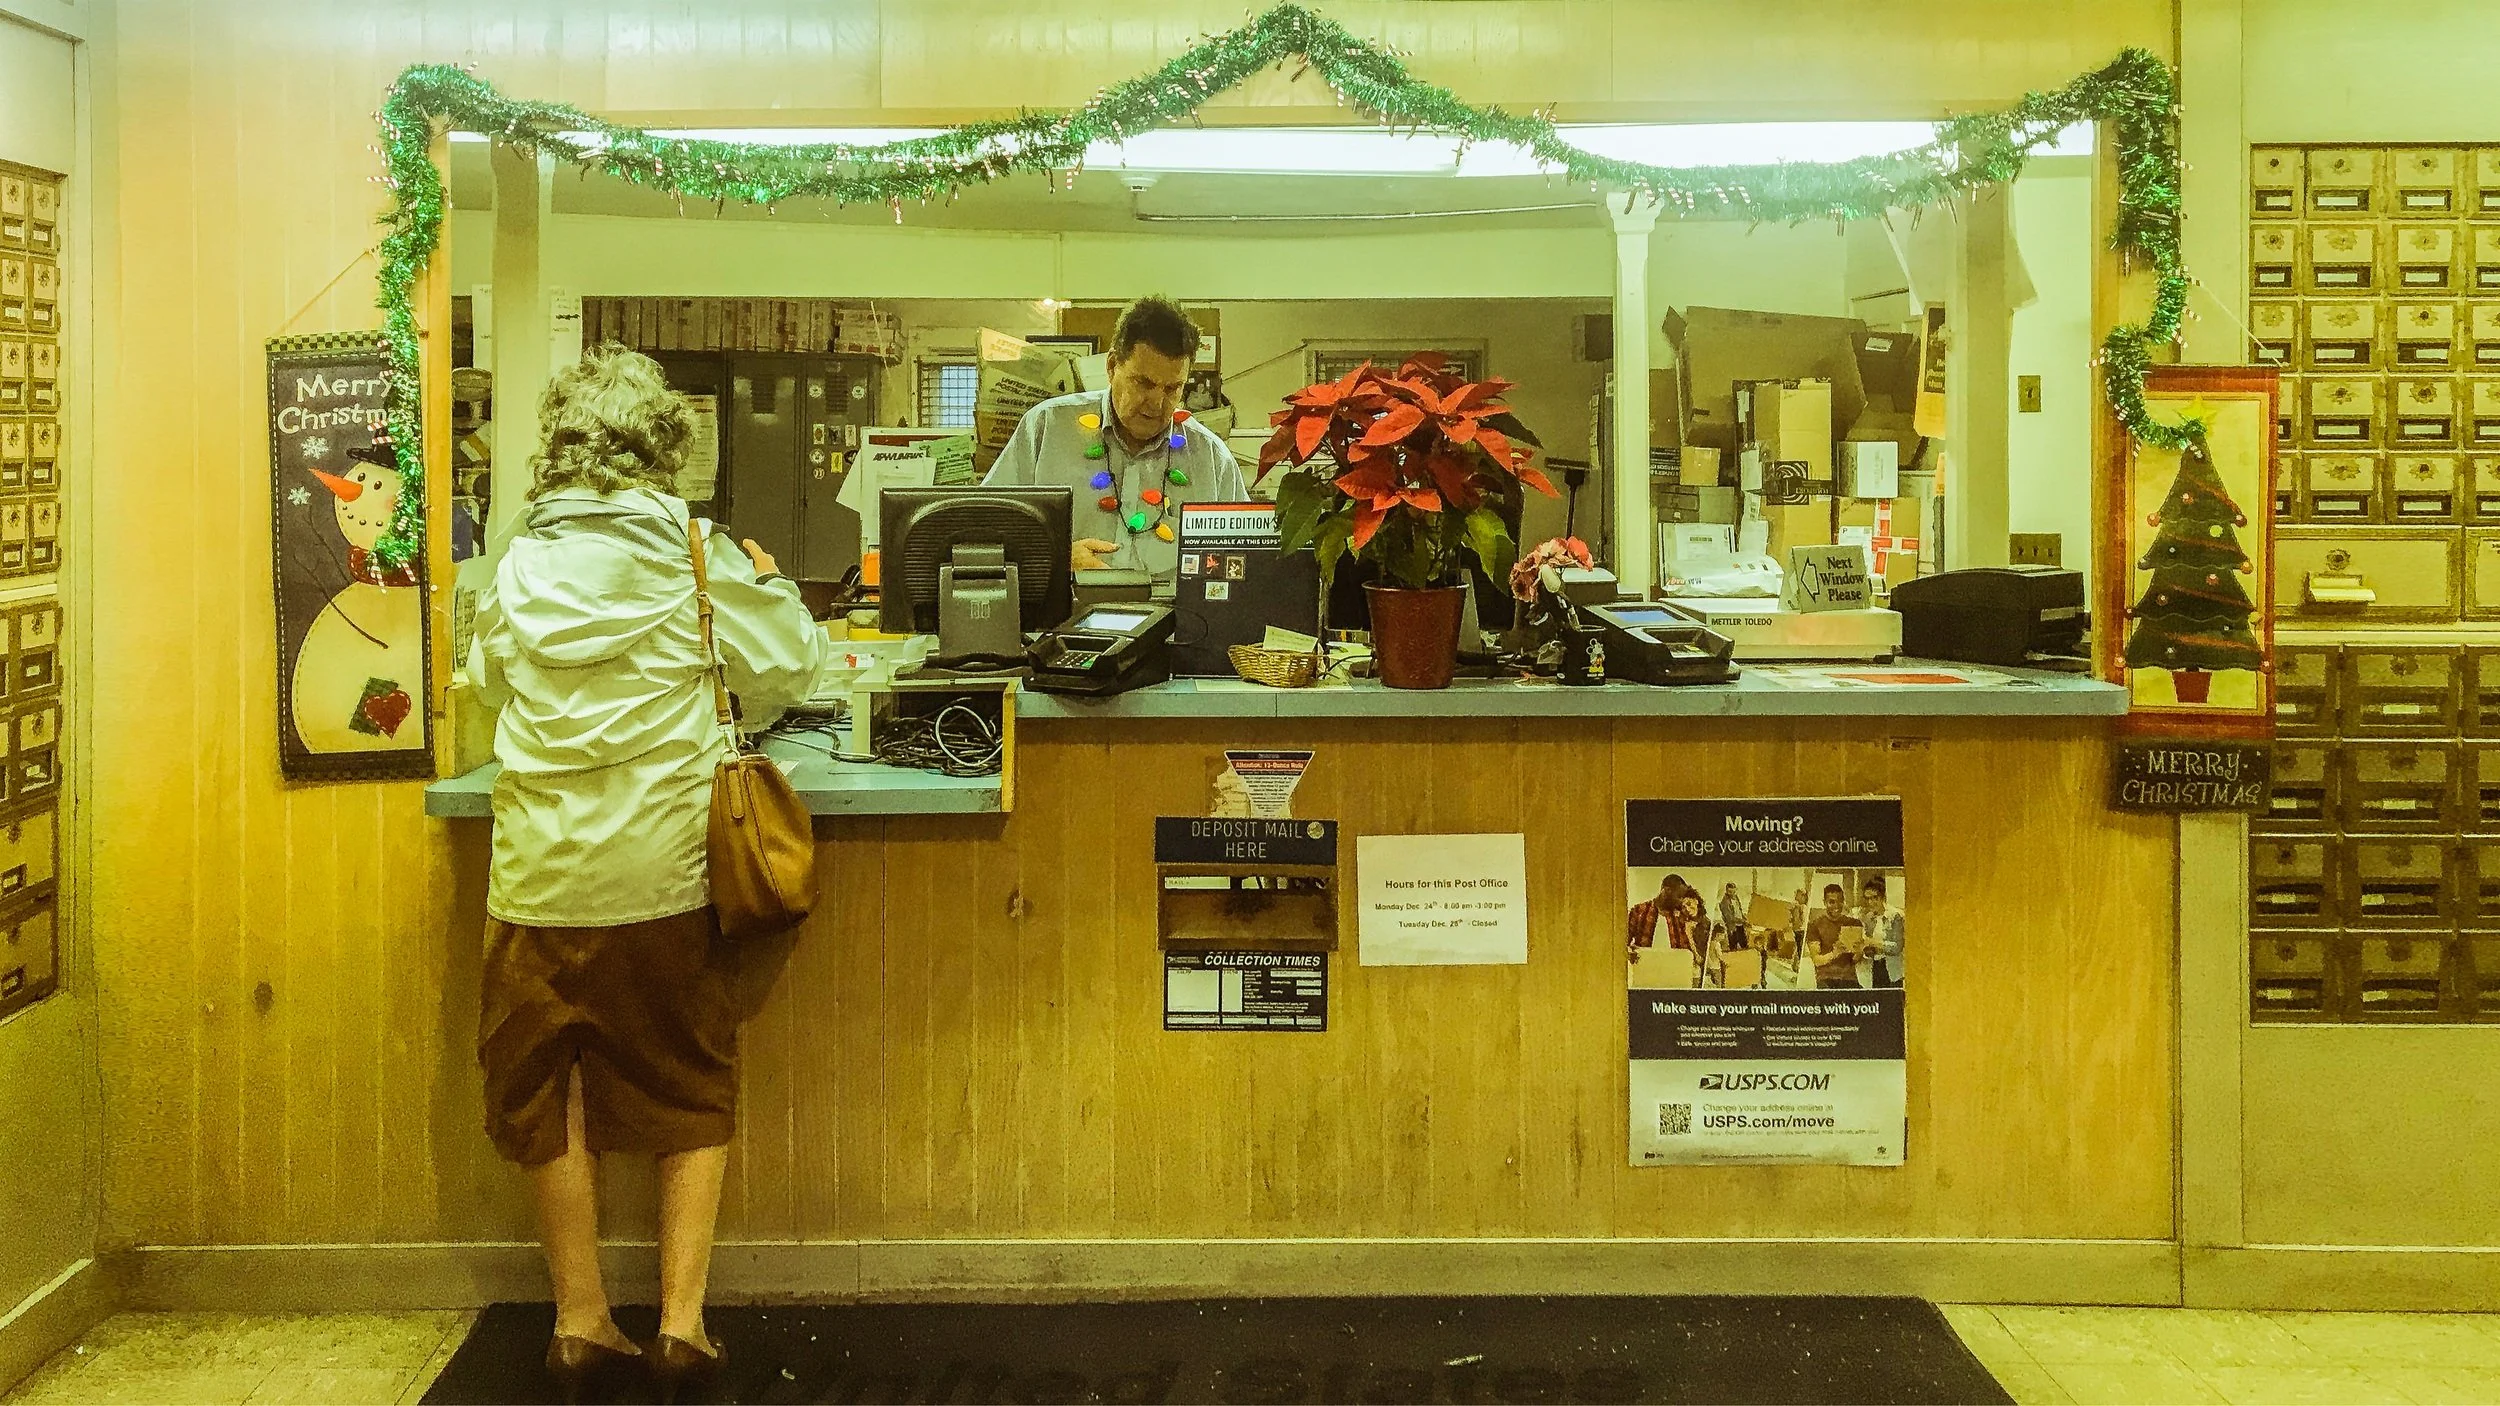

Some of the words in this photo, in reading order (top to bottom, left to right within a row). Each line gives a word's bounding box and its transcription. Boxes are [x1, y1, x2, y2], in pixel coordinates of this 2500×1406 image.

[297, 373, 392, 402] Merry
[1185, 517, 1226, 530] LIMITED
[1229, 517, 1270, 530] EDITION
[1827, 556, 1854, 570] Next
[1819, 571, 1865, 586] Window
[1828, 587, 1862, 602] Please
[1711, 617, 1742, 626] METTLER
[1744, 617, 1773, 626] TOLEDO
[2148, 750, 2240, 782] MERRY
[2122, 779, 2263, 806] CHRISTMAS
[1191, 820, 1258, 838] DEPOSIT
[1265, 821, 1303, 839] MAIL
[1725, 815, 1804, 835] Moving?
[1225, 842, 1268, 859] HERE
[1649, 836, 1714, 856] Change
[1718, 839, 1754, 856] your
[1758, 837, 1825, 853] address
[1385, 880, 1415, 889] Hours
[1417, 879, 1431, 889] for
[1434, 879, 1452, 889] this
[1454, 879, 1477, 888] Post
[1479, 878, 1508, 888] Office
[1375, 903, 1404, 911] Monday
[1494, 903, 1507, 911] pm
[1399, 921, 1429, 929] Tuesday
[1204, 955, 1282, 966] COLLECTION
[1284, 955, 1321, 966] TIMES
[1652, 1002, 1687, 1014] Make
[1689, 1004, 1717, 1014] sure
[1720, 1004, 1748, 1017] your
[1751, 1002, 1778, 1014] mail
[1780, 1004, 1821, 1014] moves
[1824, 1002, 1851, 1014] with
[1853, 1002, 1880, 1016] you!
[1703, 1103, 1737, 1113] Change
[1739, 1104, 1758, 1113] your
[1760, 1103, 1795, 1112] address
[1703, 1114, 1835, 1129] USPS.com/move
